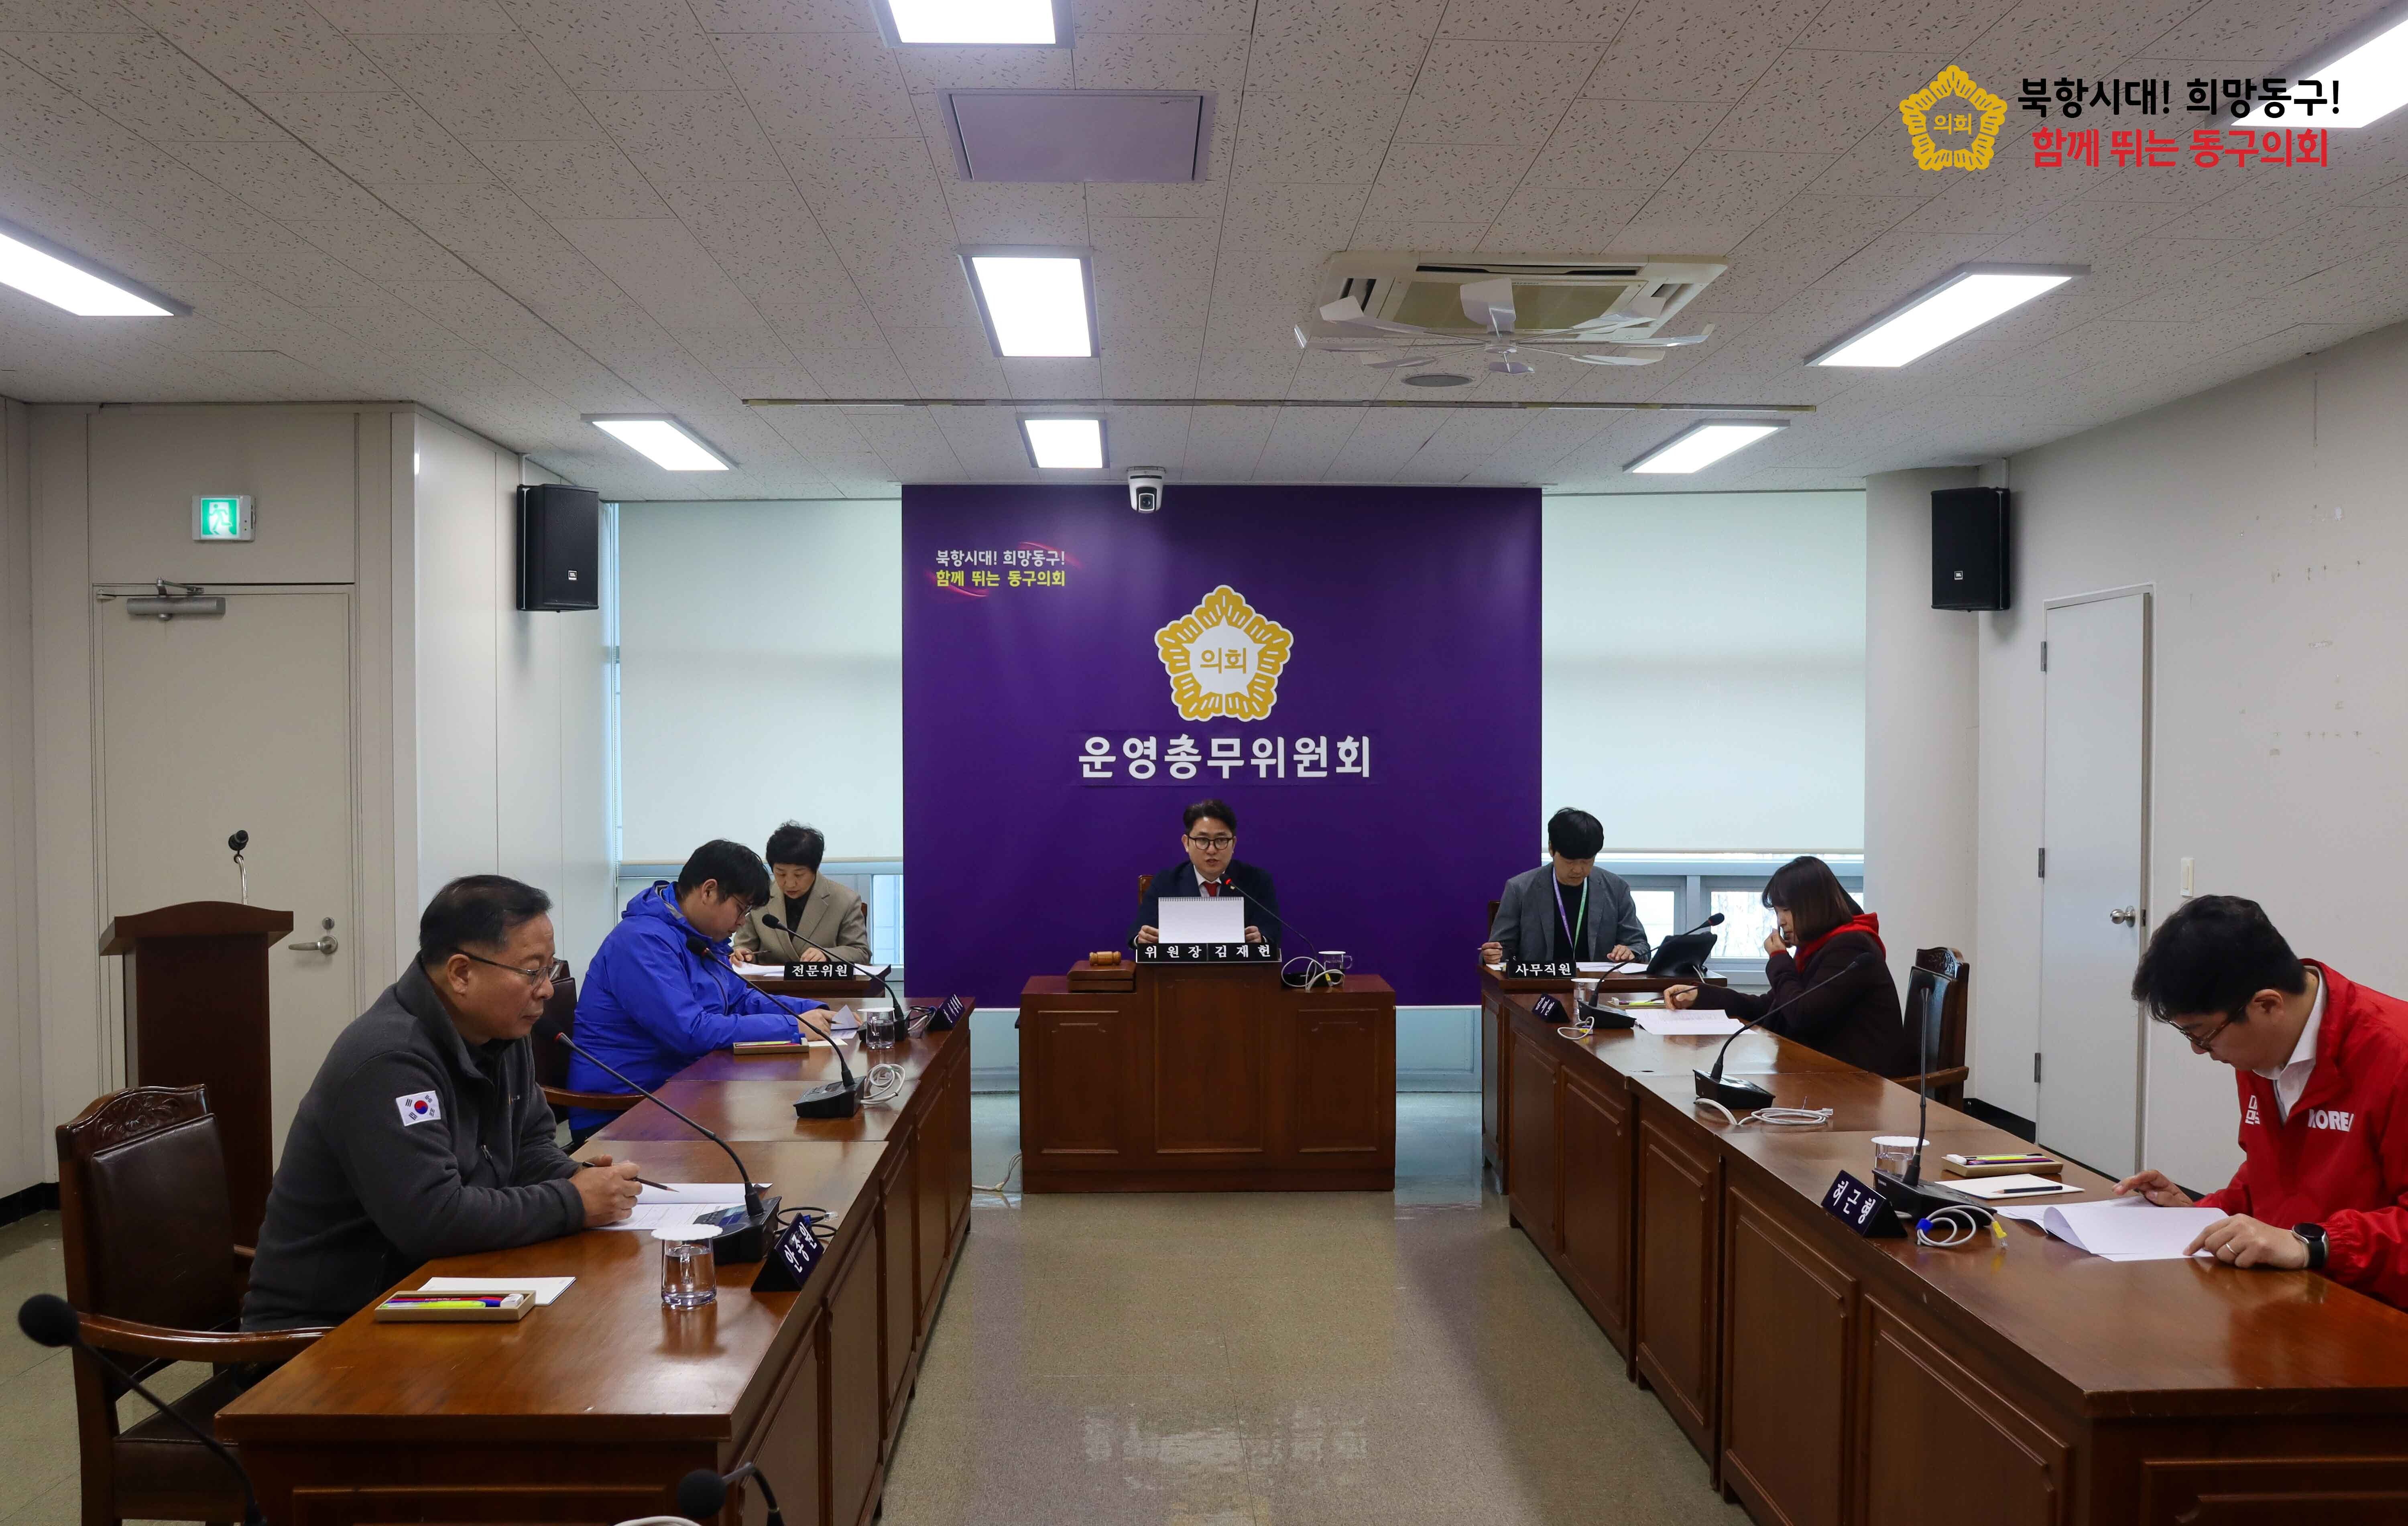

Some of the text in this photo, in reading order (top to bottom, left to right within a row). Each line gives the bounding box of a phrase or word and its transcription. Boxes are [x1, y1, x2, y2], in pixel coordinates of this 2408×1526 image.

[936, 550, 1065, 567] 북항시대! 희망동구!
[936, 570, 1065, 587] 함께 뛰는 동구의회
[1200, 647, 1247, 674] 의회
[1078, 734, 1370, 780] 운영총무위원회
[792, 964, 848, 977] 전문위원
[1515, 963, 1572, 976] 사무직원
[784, 1221, 818, 1273] 안종원
